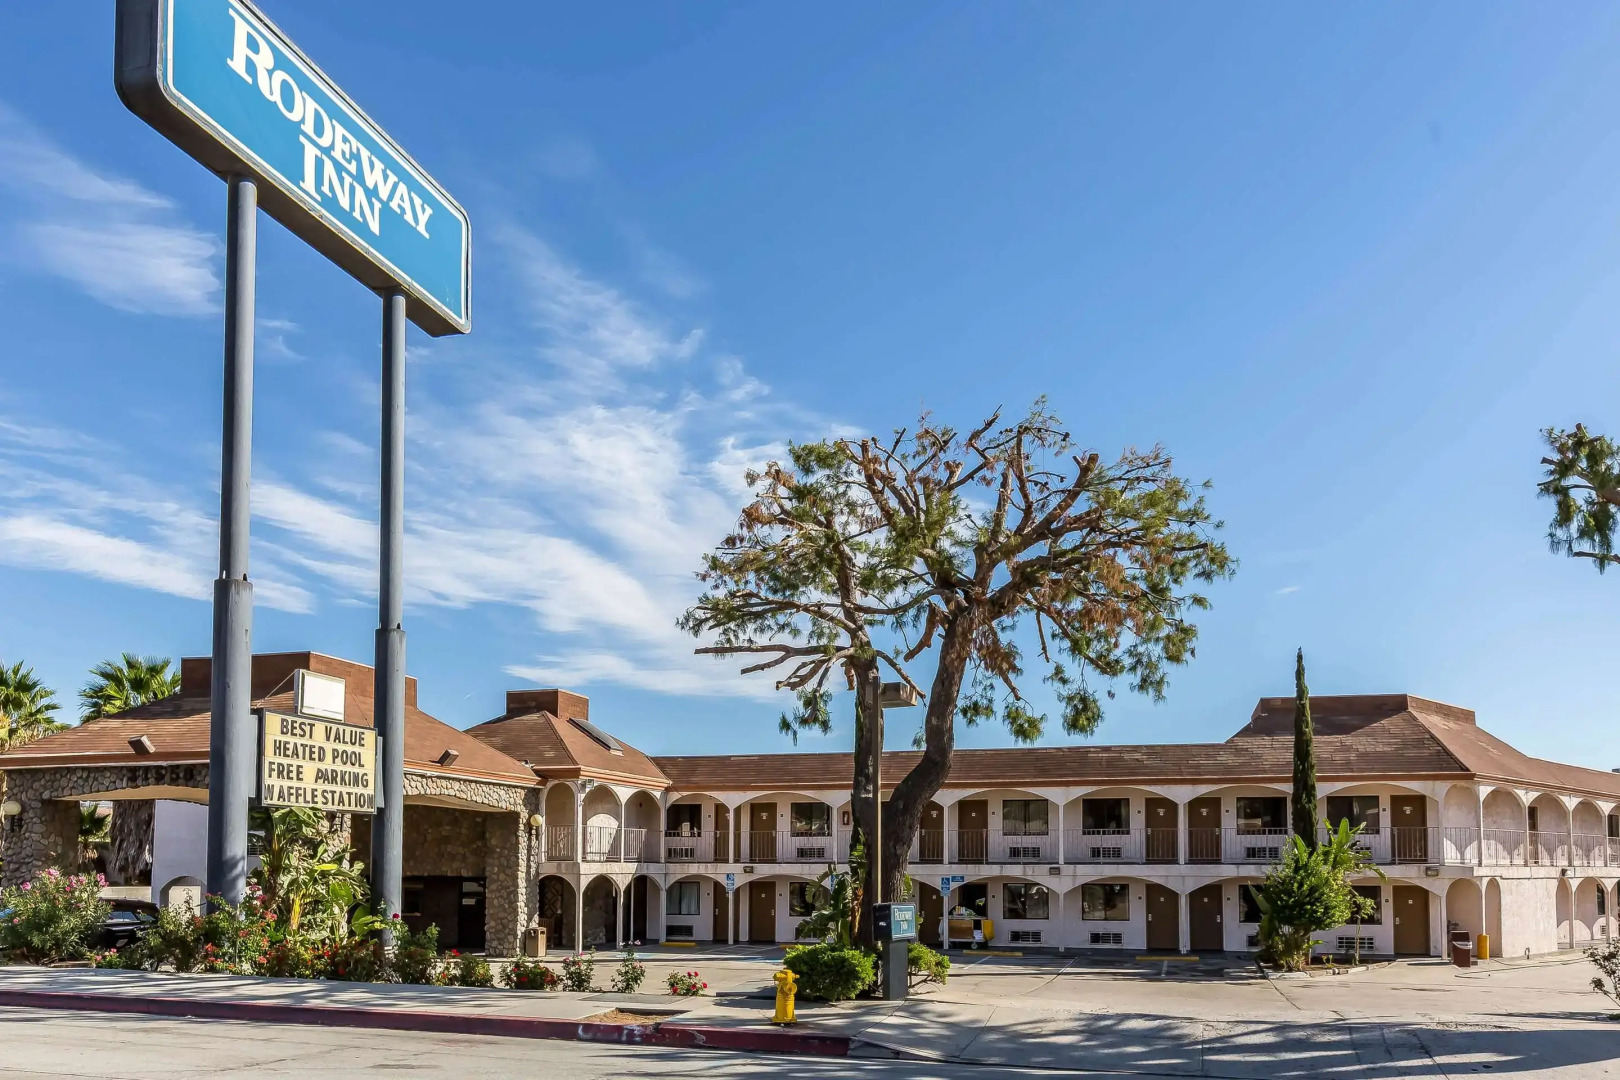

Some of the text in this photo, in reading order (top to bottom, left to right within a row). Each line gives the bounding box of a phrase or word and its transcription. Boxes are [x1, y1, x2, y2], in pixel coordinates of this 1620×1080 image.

[227, 8, 433, 239] RODEWAY
[299, 134, 382, 236] INN
[280, 718, 365, 747] BEST VALUE
[273, 739, 364, 768] HEATED POOL
[268, 761, 369, 788] FREE PARKING
[264, 784, 374, 809] WAFFLE STATION
